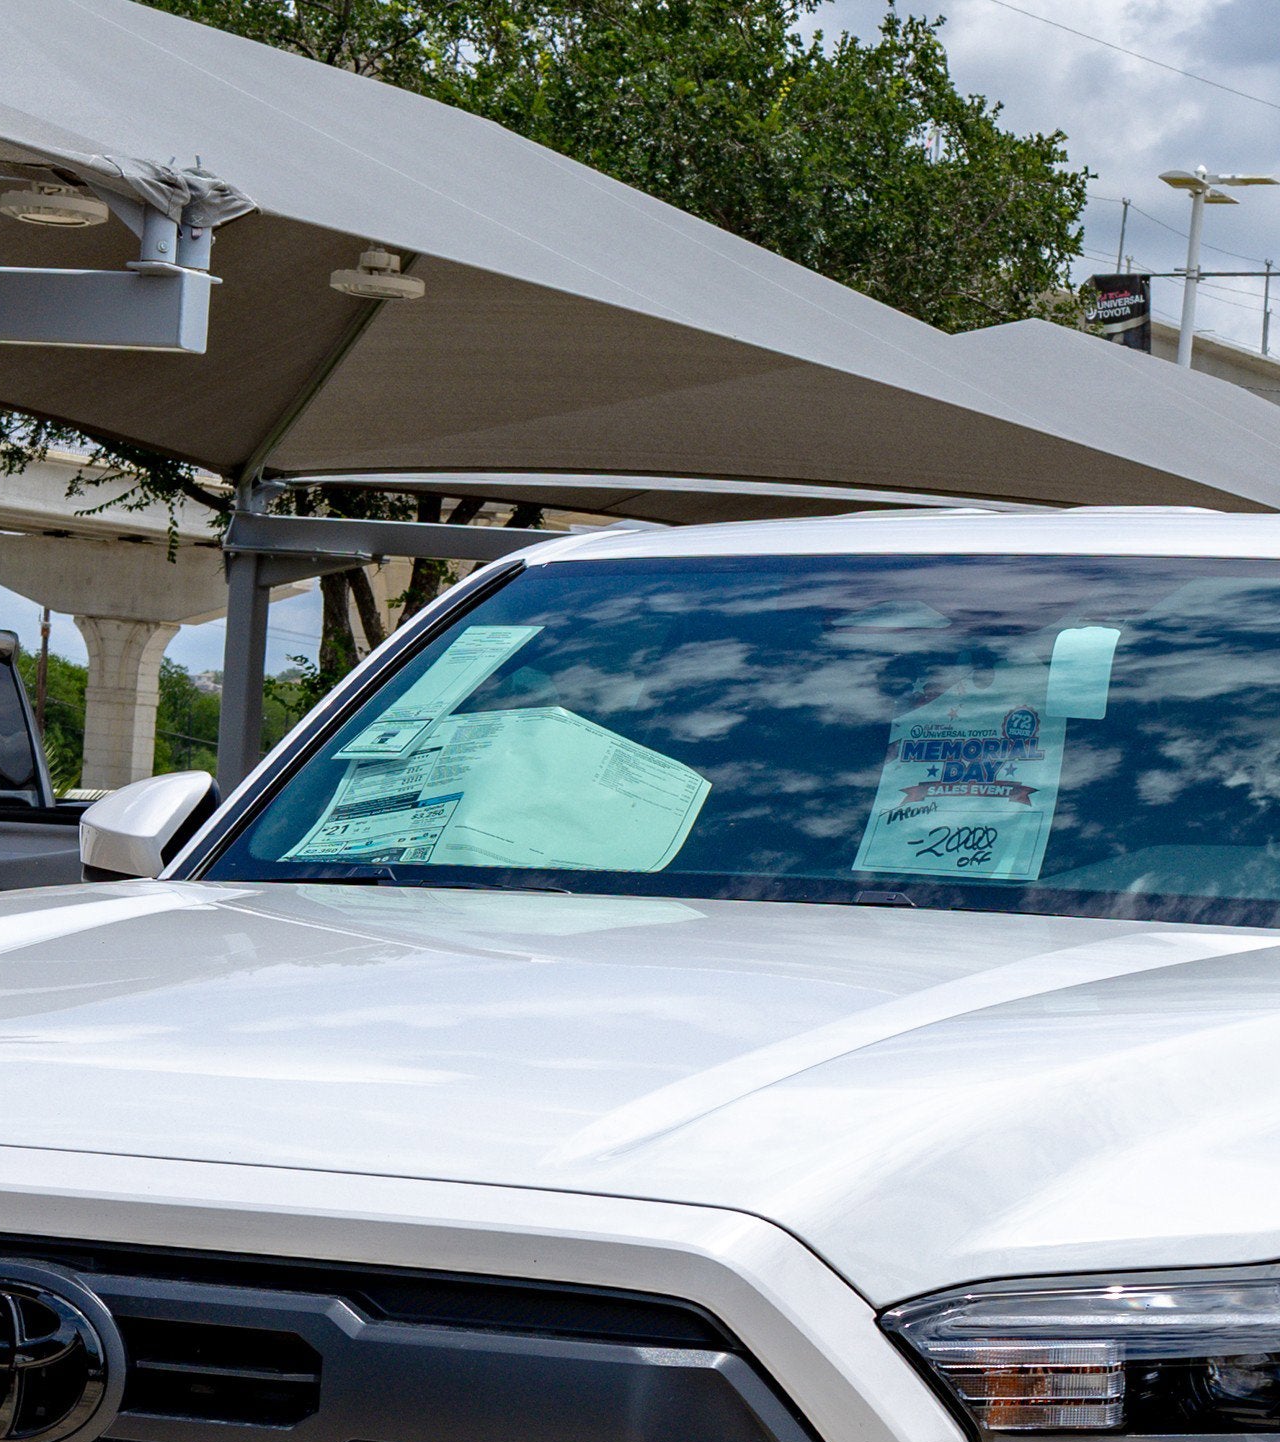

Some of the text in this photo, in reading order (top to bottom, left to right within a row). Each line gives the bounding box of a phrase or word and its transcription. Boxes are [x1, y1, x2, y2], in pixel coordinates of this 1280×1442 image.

[1097, 294, 1146, 310] UNIVERSAL
[1097, 307, 1131, 319] TOYOTA
[1011, 714, 1032, 730] 72
[923, 730, 966, 738] UNIVERSAL
[969, 729, 998, 737] TOYOTA
[900, 737, 1045, 763] MEMORIAL
[941, 760, 1008, 784] DAY
[927, 784, 1014, 797] SALES EVENT
[326, 824, 350, 836] 21
